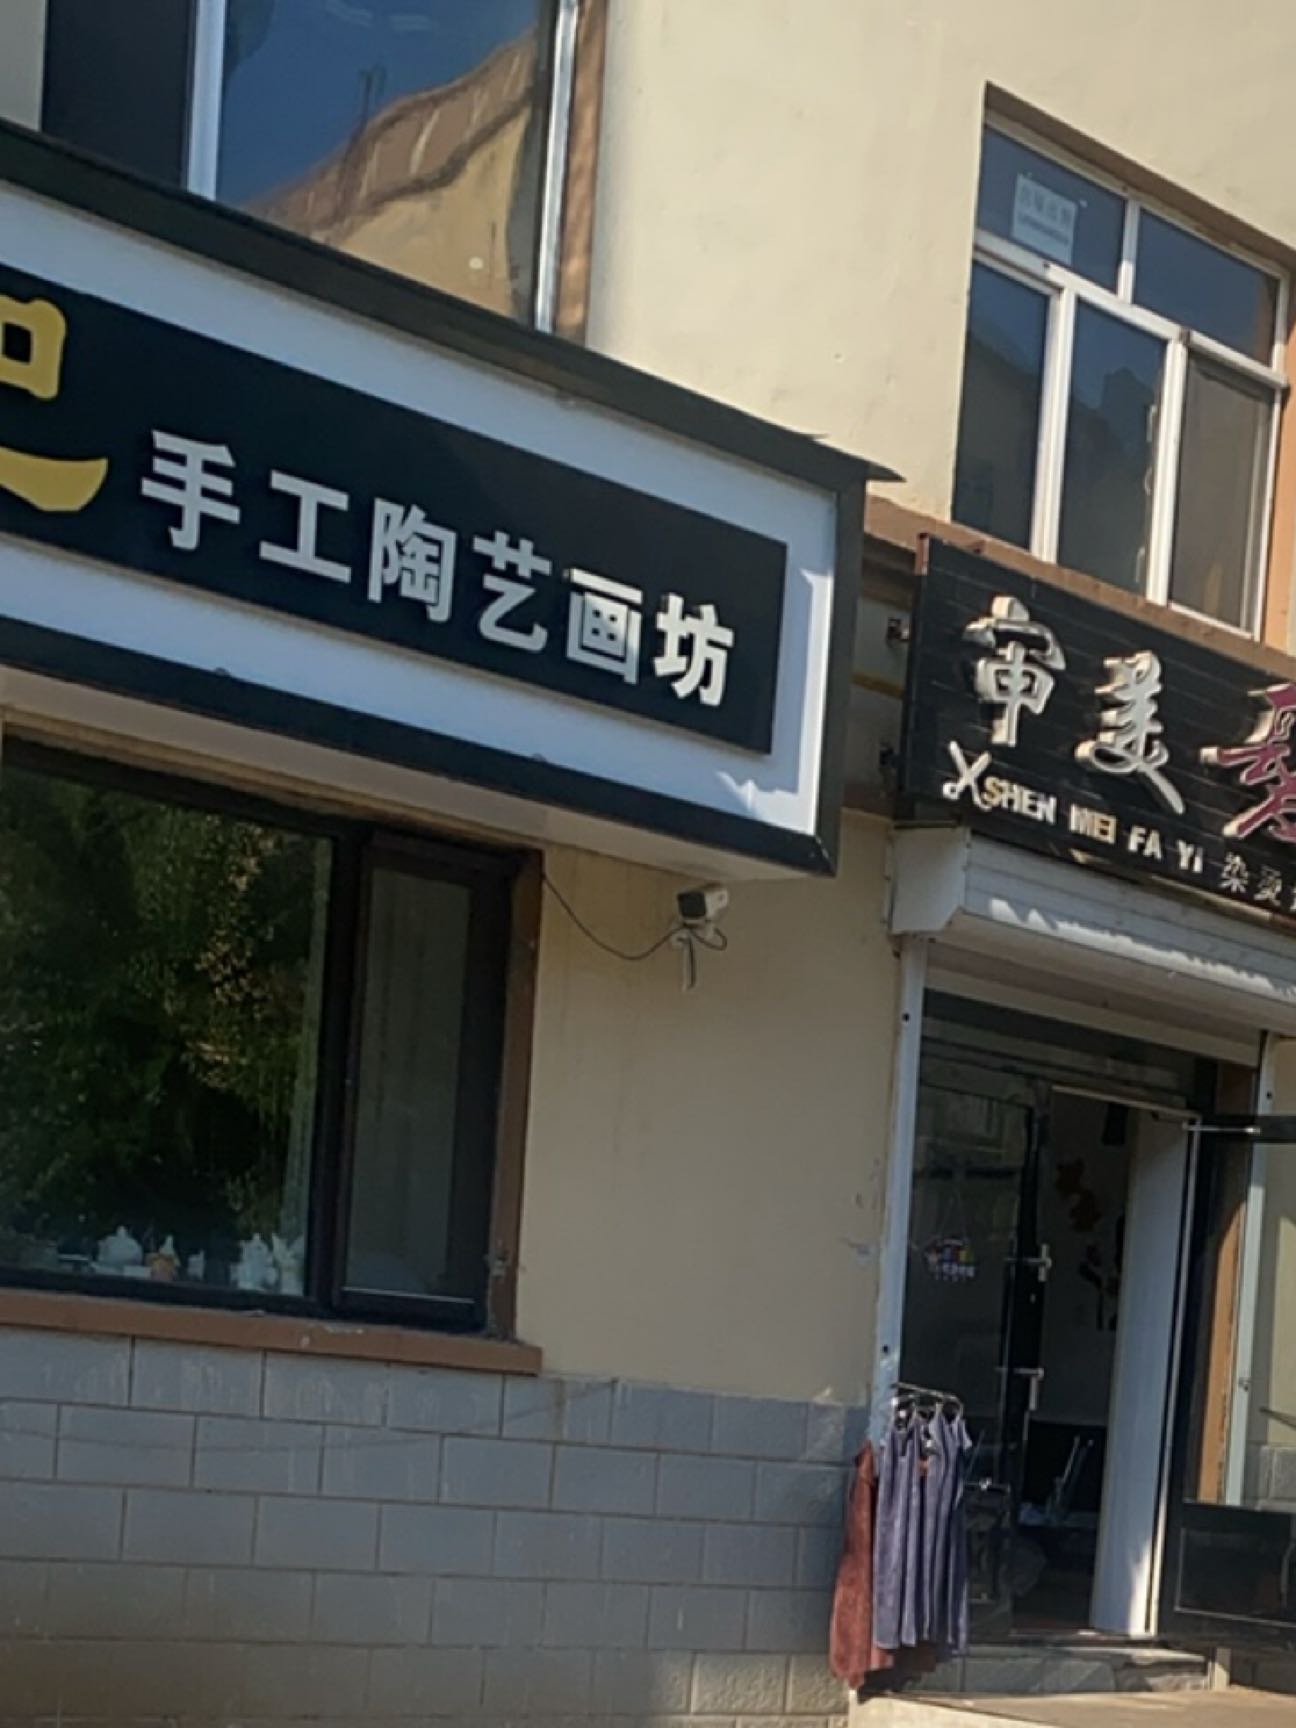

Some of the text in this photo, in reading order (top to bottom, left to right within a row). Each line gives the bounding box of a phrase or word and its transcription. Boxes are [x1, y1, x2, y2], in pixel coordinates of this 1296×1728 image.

[141, 430, 735, 707] 手工陶艺画坊
[981, 776, 1058, 825] SHEN
[1068, 804, 1118, 845] MEI
[1128, 825, 1162, 860] FA
